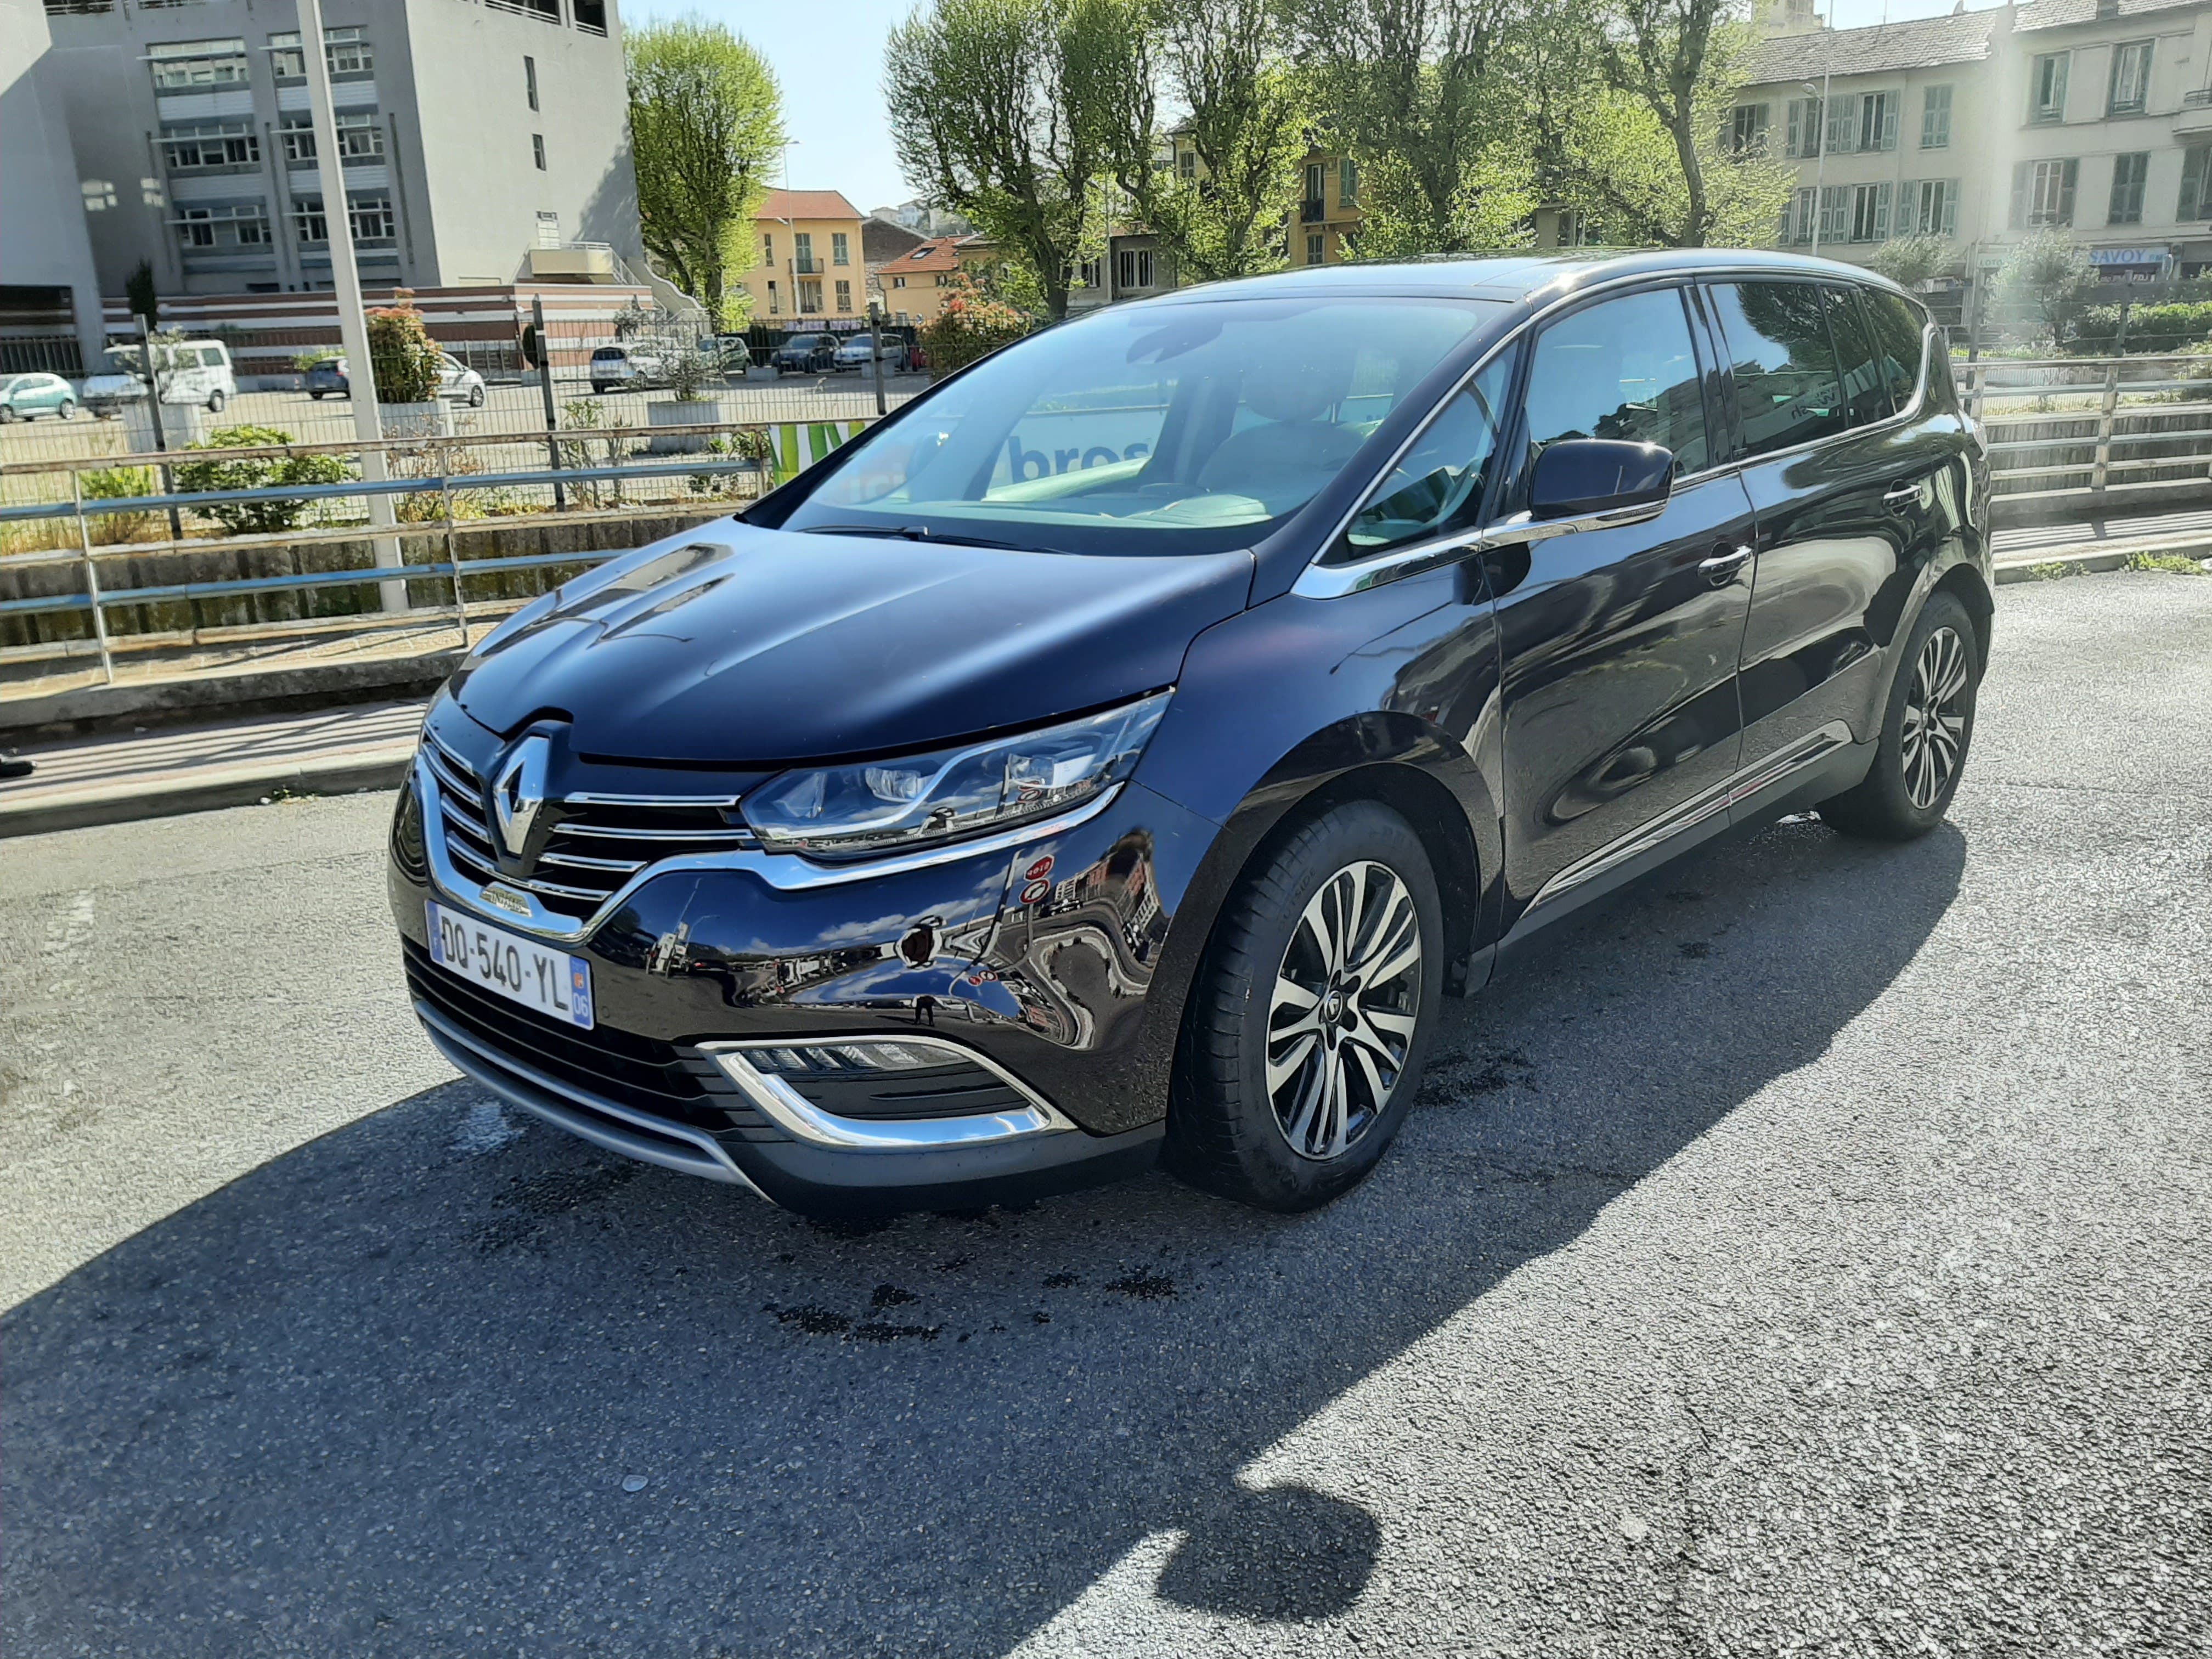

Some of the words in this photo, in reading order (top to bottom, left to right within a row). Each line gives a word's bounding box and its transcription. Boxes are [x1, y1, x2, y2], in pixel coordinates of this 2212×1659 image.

[2089, 249, 2146, 263] SAVOY
[441, 915, 569, 1011] DQ-540-YL
[573, 992, 589, 1017] 06
